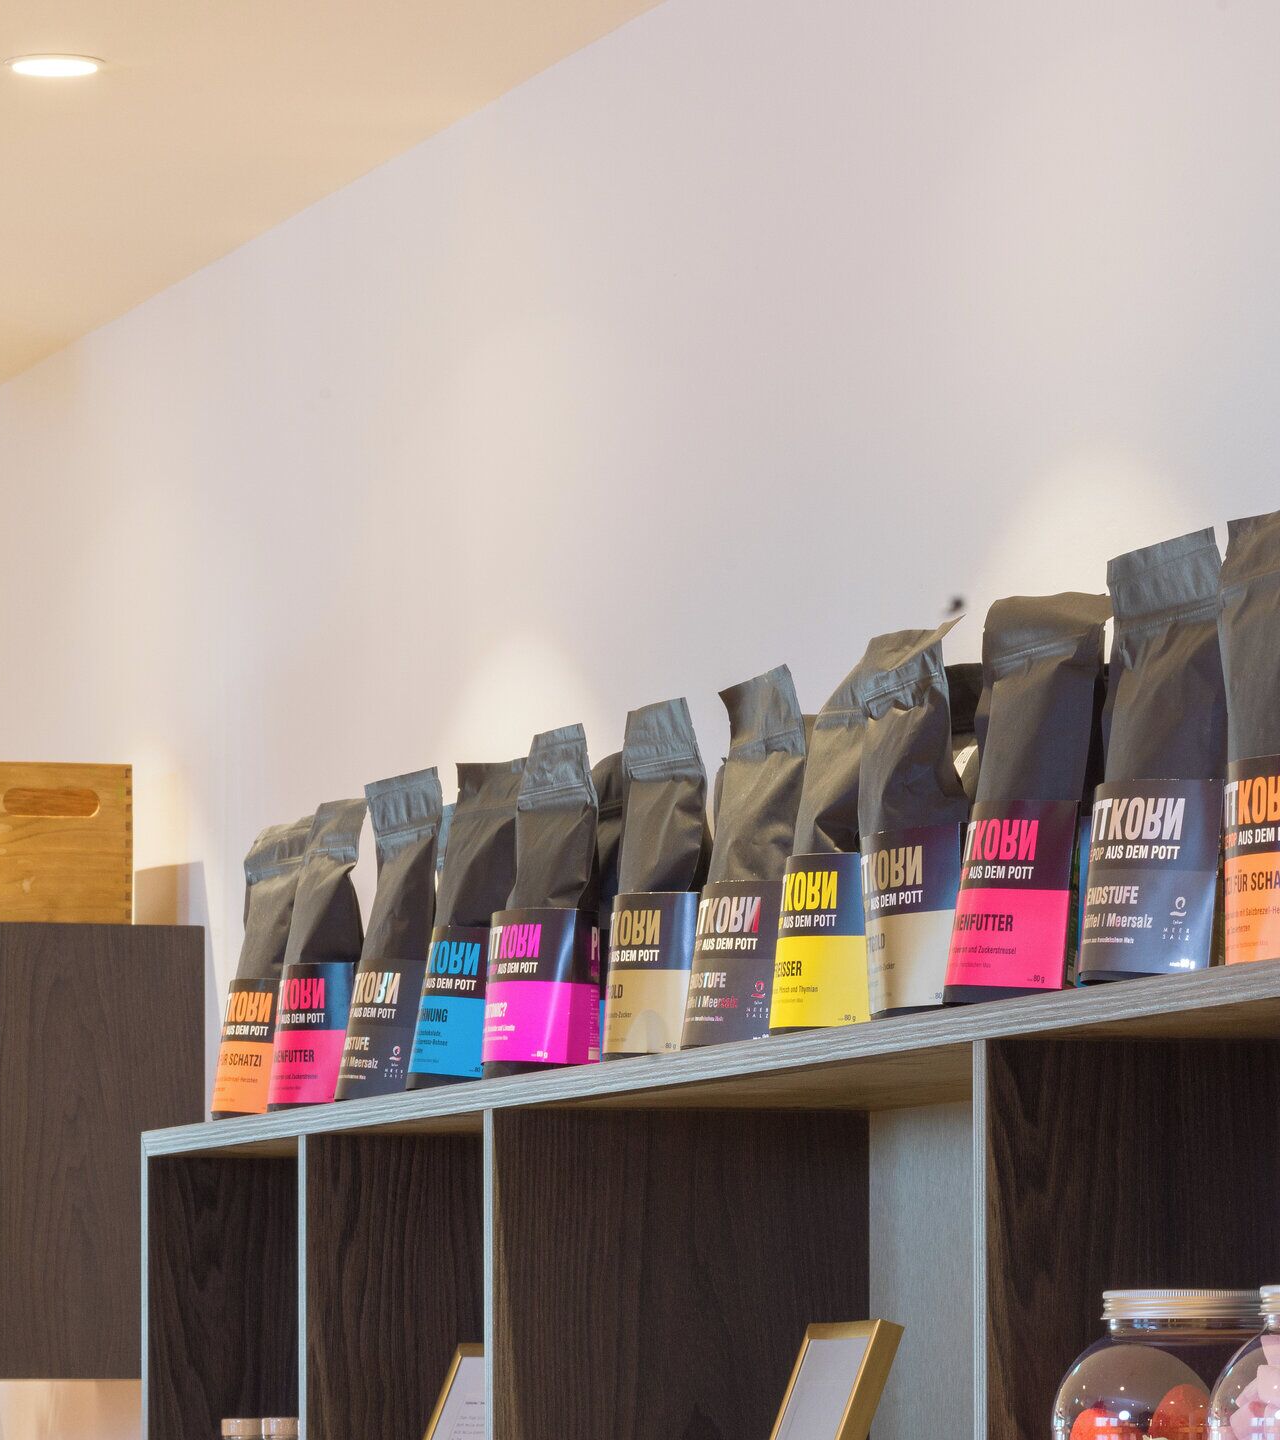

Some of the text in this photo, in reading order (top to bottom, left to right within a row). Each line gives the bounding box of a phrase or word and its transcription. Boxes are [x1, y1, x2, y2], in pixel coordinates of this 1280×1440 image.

[1238, 831, 1253, 846] AUS
[1255, 829, 1275, 843] DEM
[1106, 845, 1180, 859] AUS DEM POTT
[969, 865, 1033, 880] AUS DEM POTT
[881, 893, 896, 908] DEM
[899, 890, 923, 904] POTT
[783, 915, 837, 928] AUS DEM POTT
[1107, 913, 1153, 929] Meersalz
[702, 938, 758, 951] AUS DEM POTT
[621, 950, 637, 962] DEM
[638, 950, 660, 962] POTT
[498, 962, 538, 974] AUS DEM POTT
[426, 978, 476, 991] AUS DEM POTT
[1033, 975, 1041, 983] 80
[291, 1013, 305, 1024] DEM
[306, 1013, 325, 1024] POTT
[353, 1007, 396, 1019] AUS DEM POTT
[235, 1026, 249, 1036] DEM
[250, 1025, 268, 1036] POTT
[228, 1053, 262, 1067] SCHATZI
